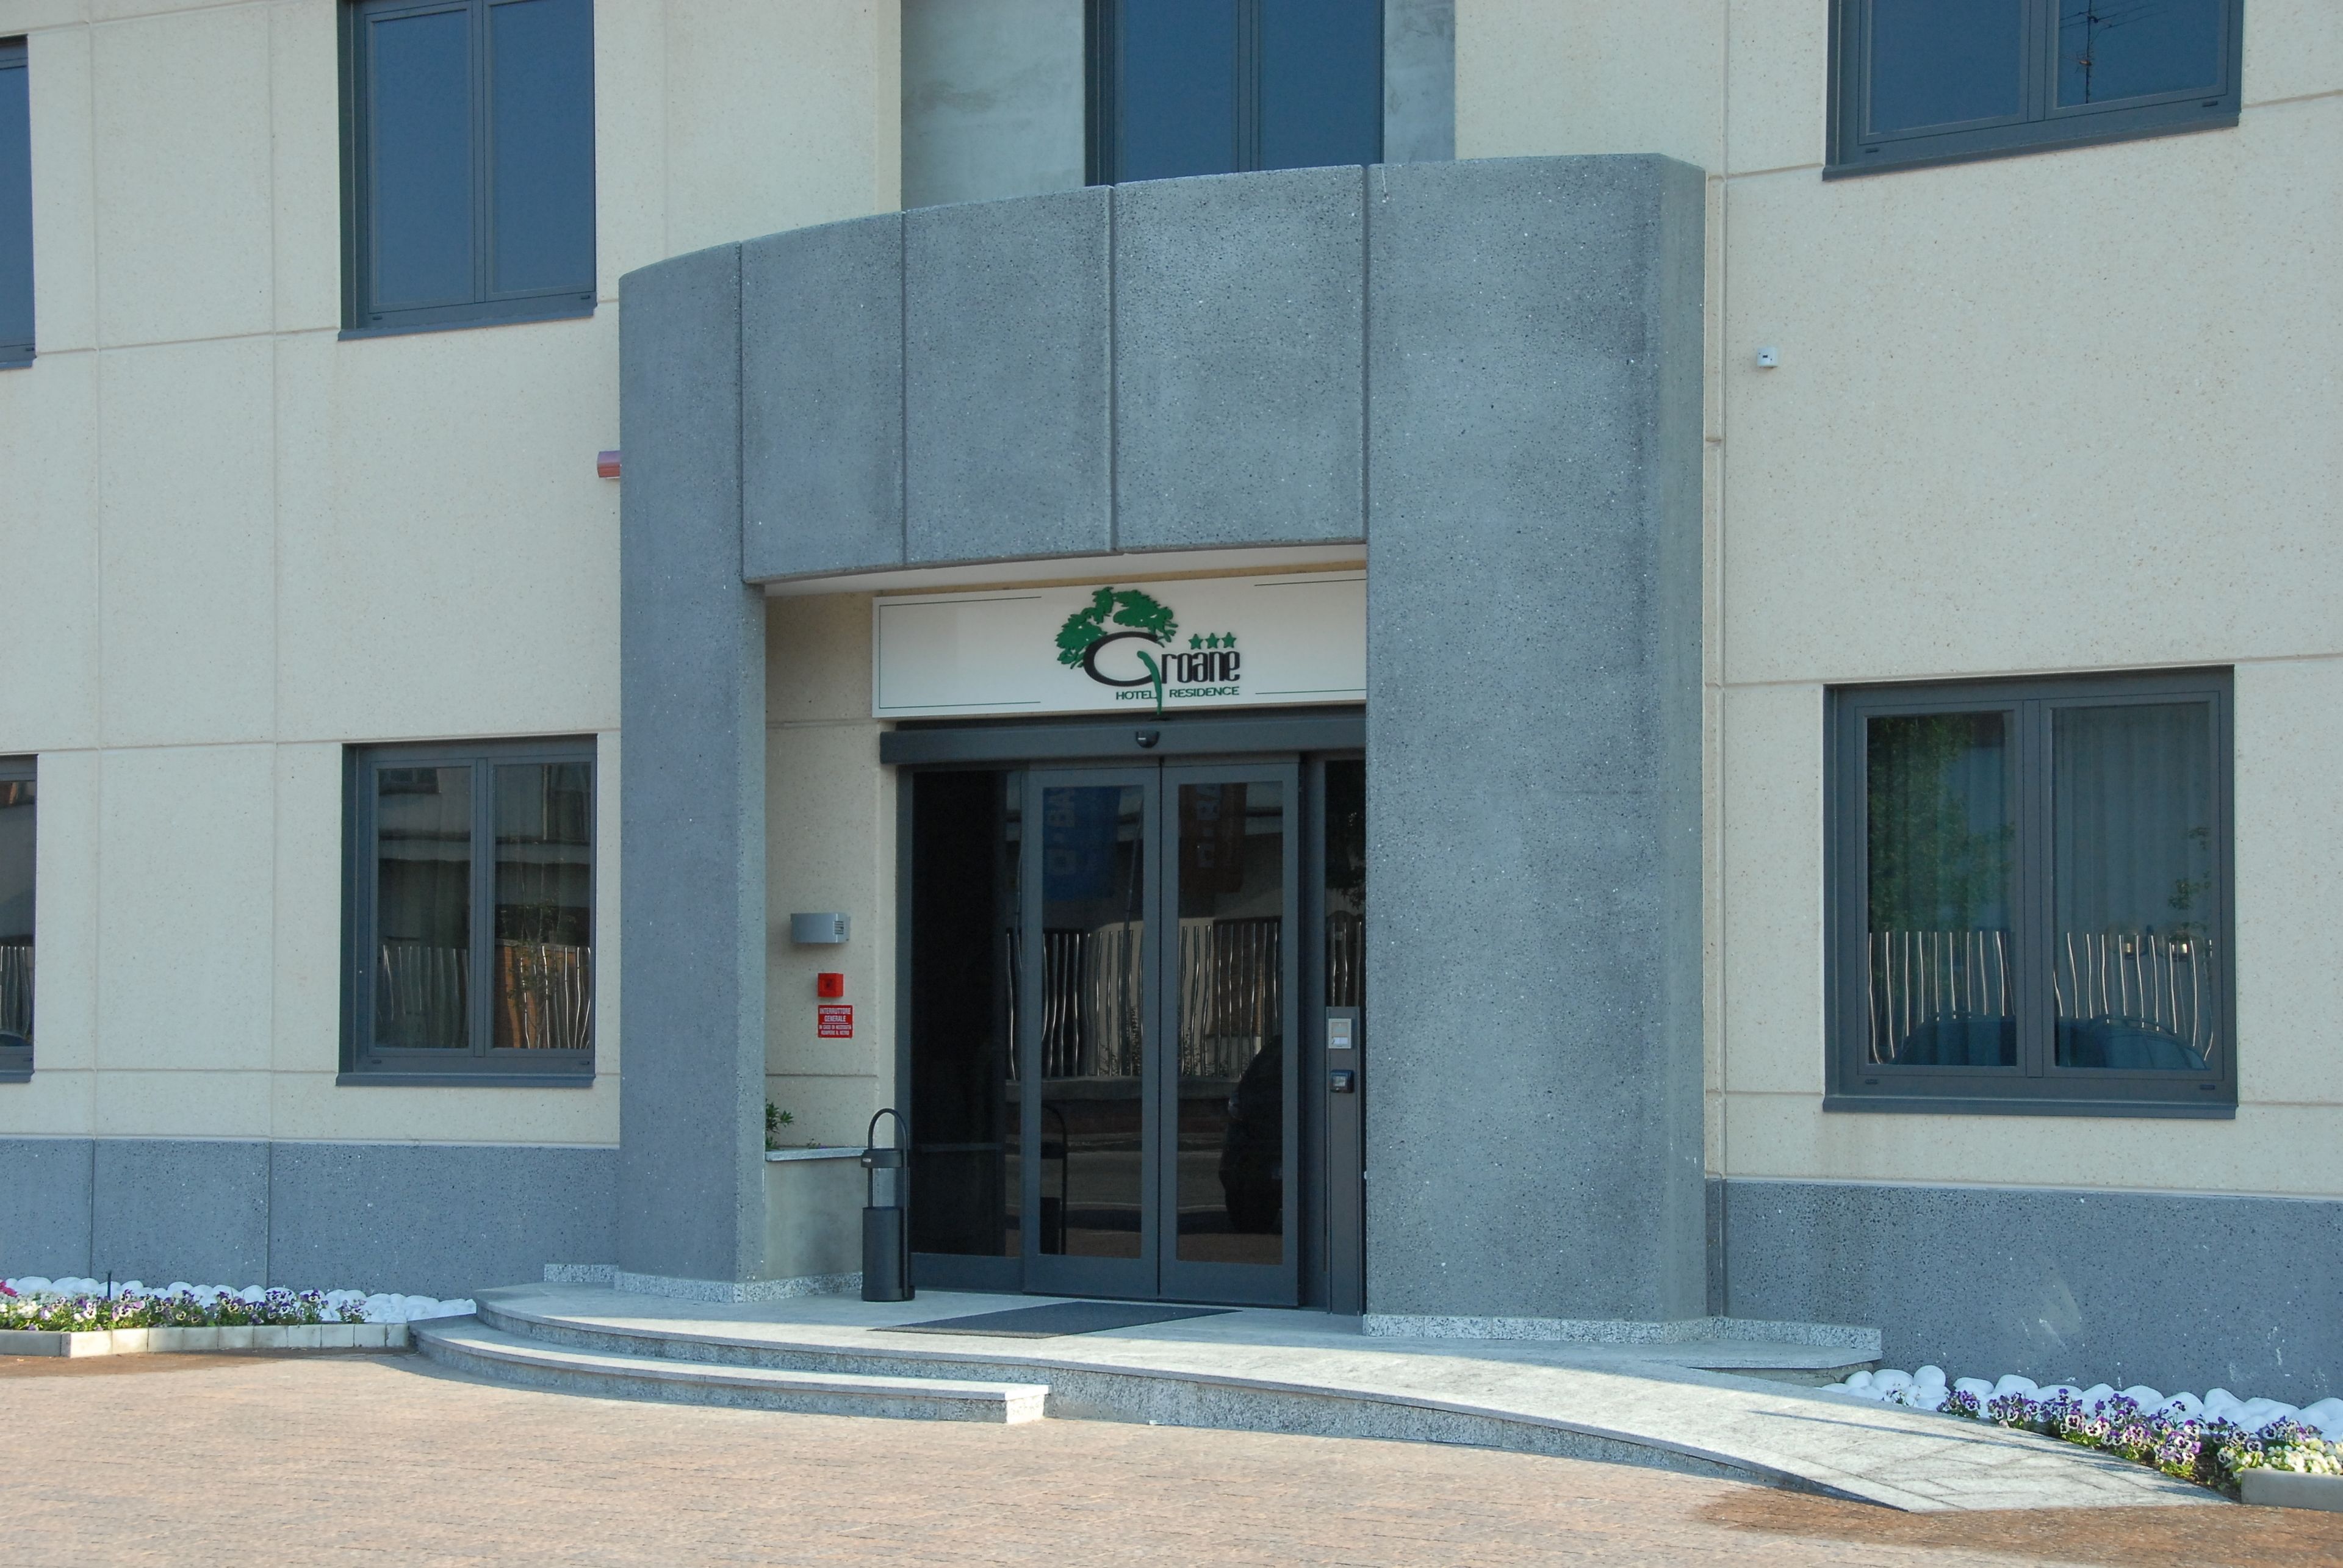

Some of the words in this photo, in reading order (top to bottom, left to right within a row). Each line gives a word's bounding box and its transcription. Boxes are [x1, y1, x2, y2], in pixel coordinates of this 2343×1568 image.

[1083, 631, 1240, 688] Groane
[1116, 690, 1157, 700] HOTEL
[1169, 686, 1240, 698] RESIDENCE
